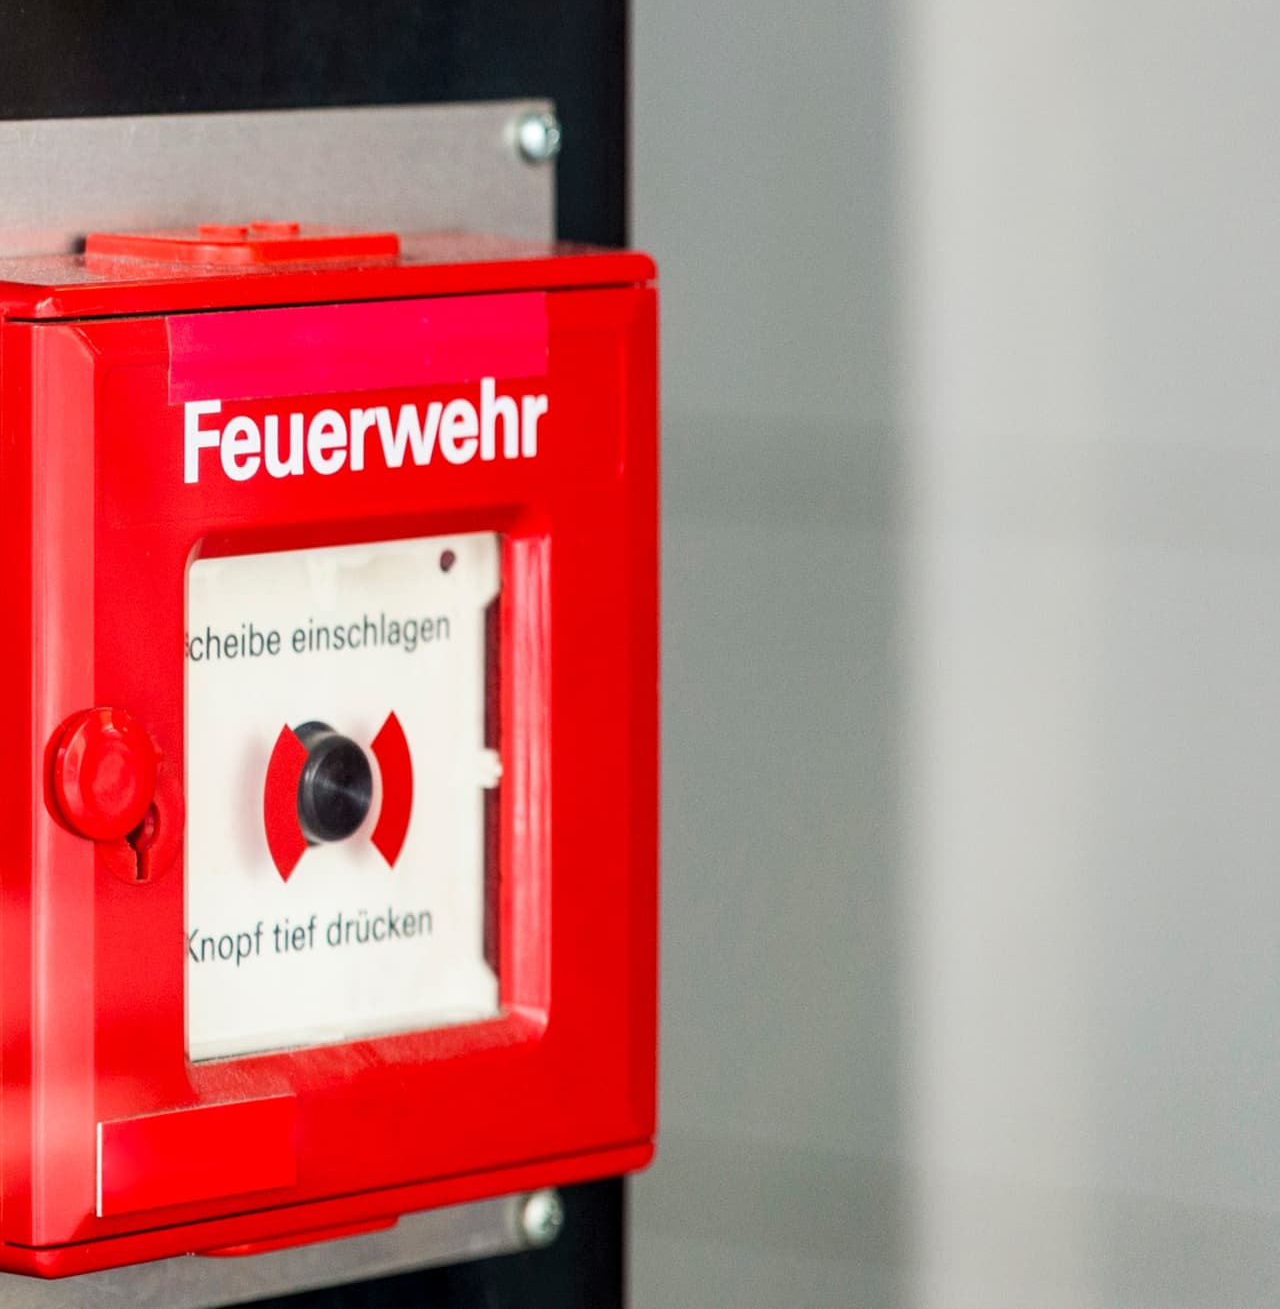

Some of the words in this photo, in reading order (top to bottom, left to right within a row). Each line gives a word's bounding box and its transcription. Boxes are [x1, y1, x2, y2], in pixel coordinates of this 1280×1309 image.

[184, 377, 548, 483] Feuerwehr
[292, 612, 451, 653] einschlagen
[273, 915, 317, 953] tief
[327, 906, 433, 947] drücken
